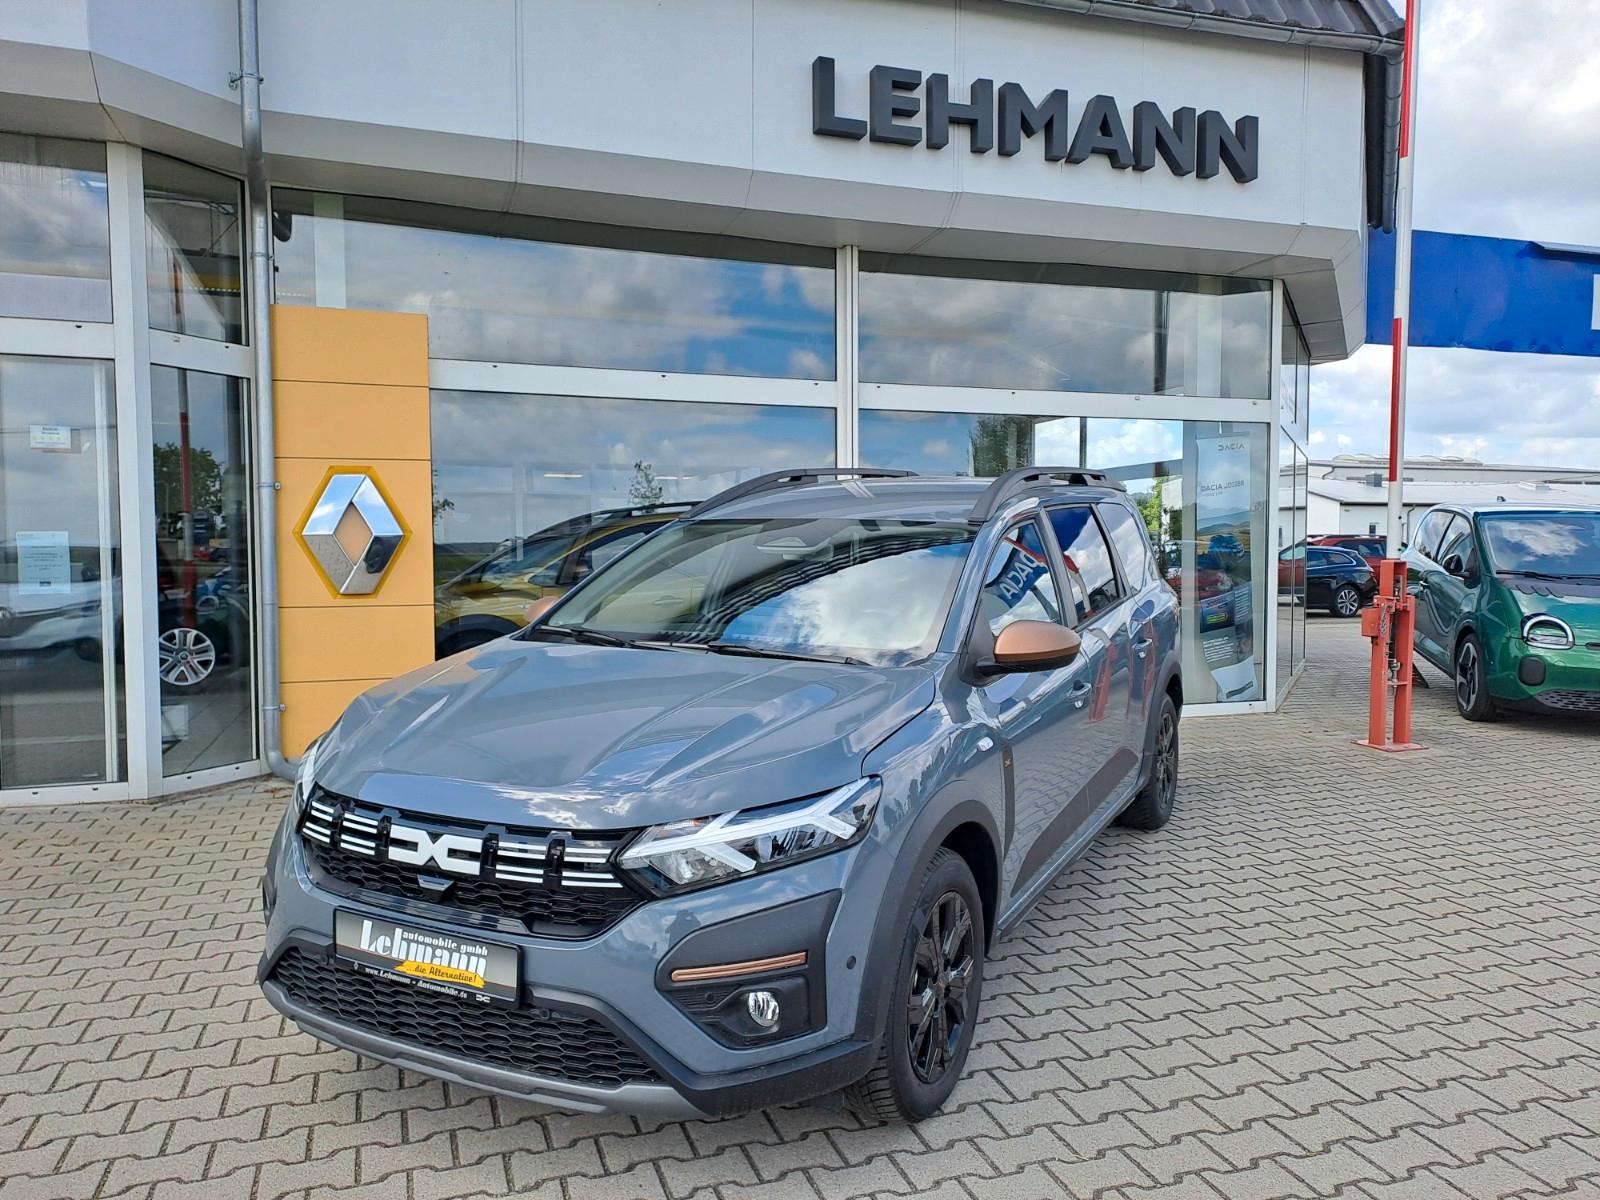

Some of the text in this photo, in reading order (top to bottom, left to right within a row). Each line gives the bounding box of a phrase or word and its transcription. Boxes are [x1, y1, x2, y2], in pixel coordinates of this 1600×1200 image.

[812, 56, 1259, 184] LEHMANN
[360, 919, 487, 980] Lehmann
[402, 931, 488, 956] automobile gmbh
